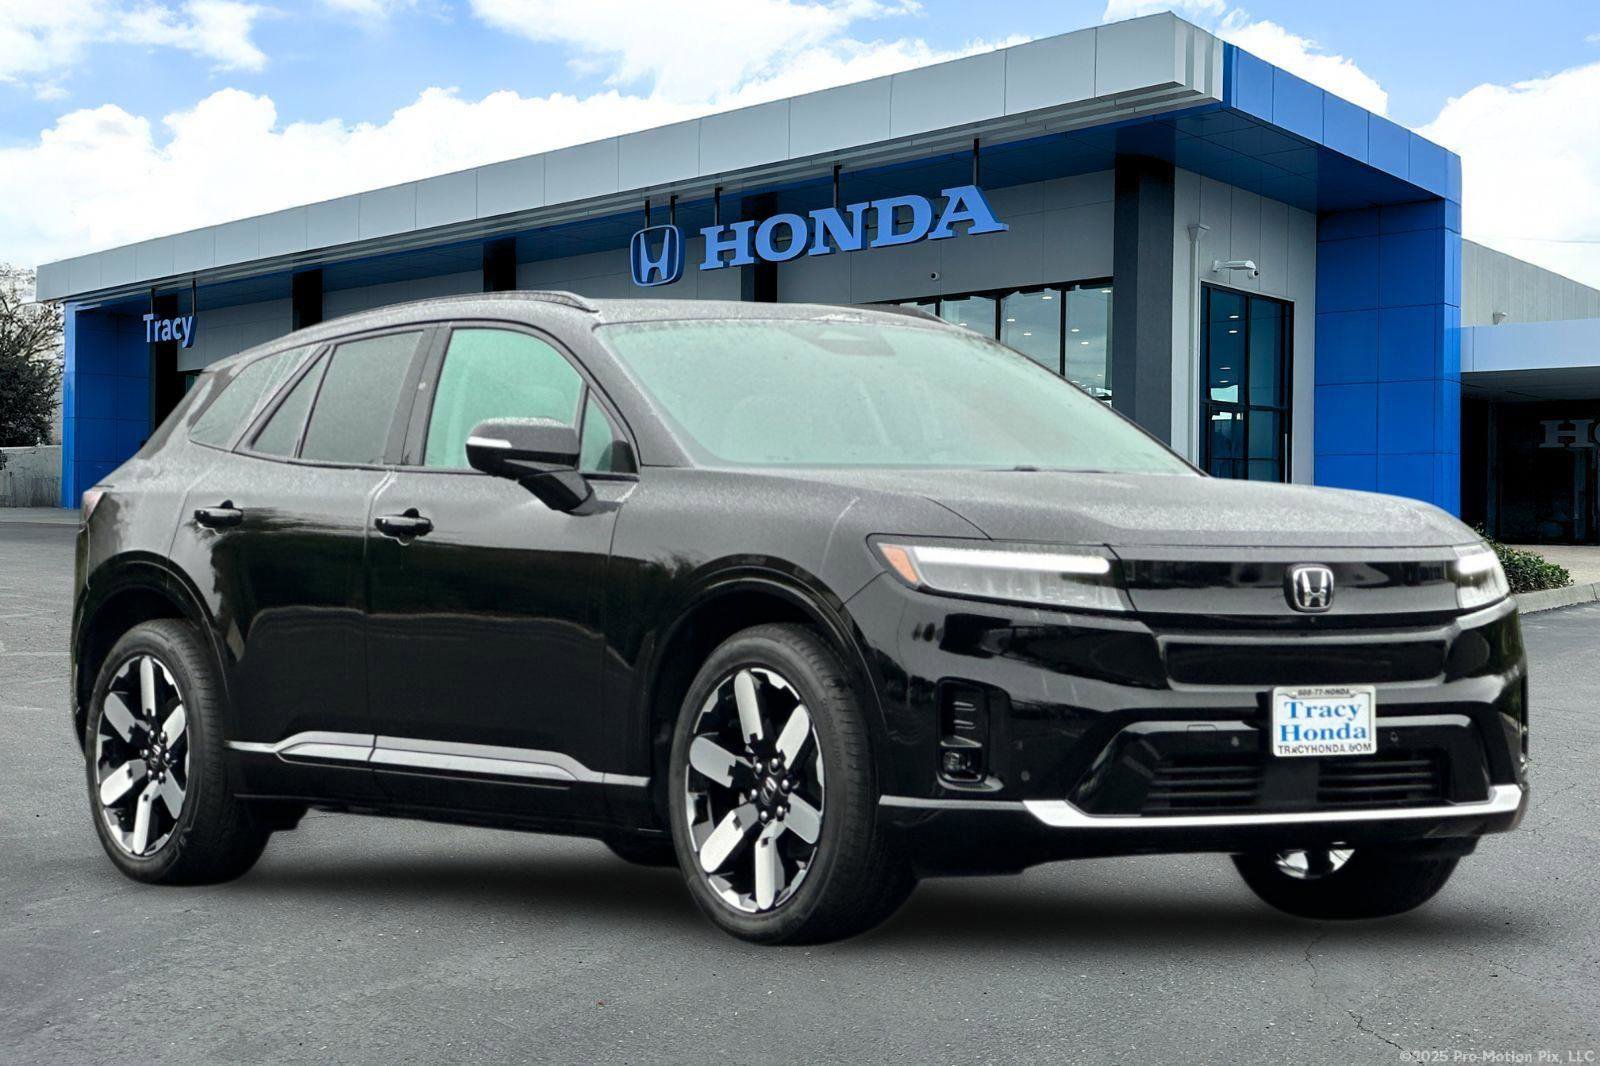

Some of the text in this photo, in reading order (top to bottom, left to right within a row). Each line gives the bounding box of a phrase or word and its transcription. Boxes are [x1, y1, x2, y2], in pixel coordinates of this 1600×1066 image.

[700, 184, 1009, 271] HONDA
[143, 313, 195, 348] Tracy
[1539, 419, 1600, 448] H
[1284, 701, 1361, 721] Tracy
[1280, 722, 1366, 742] Honda
